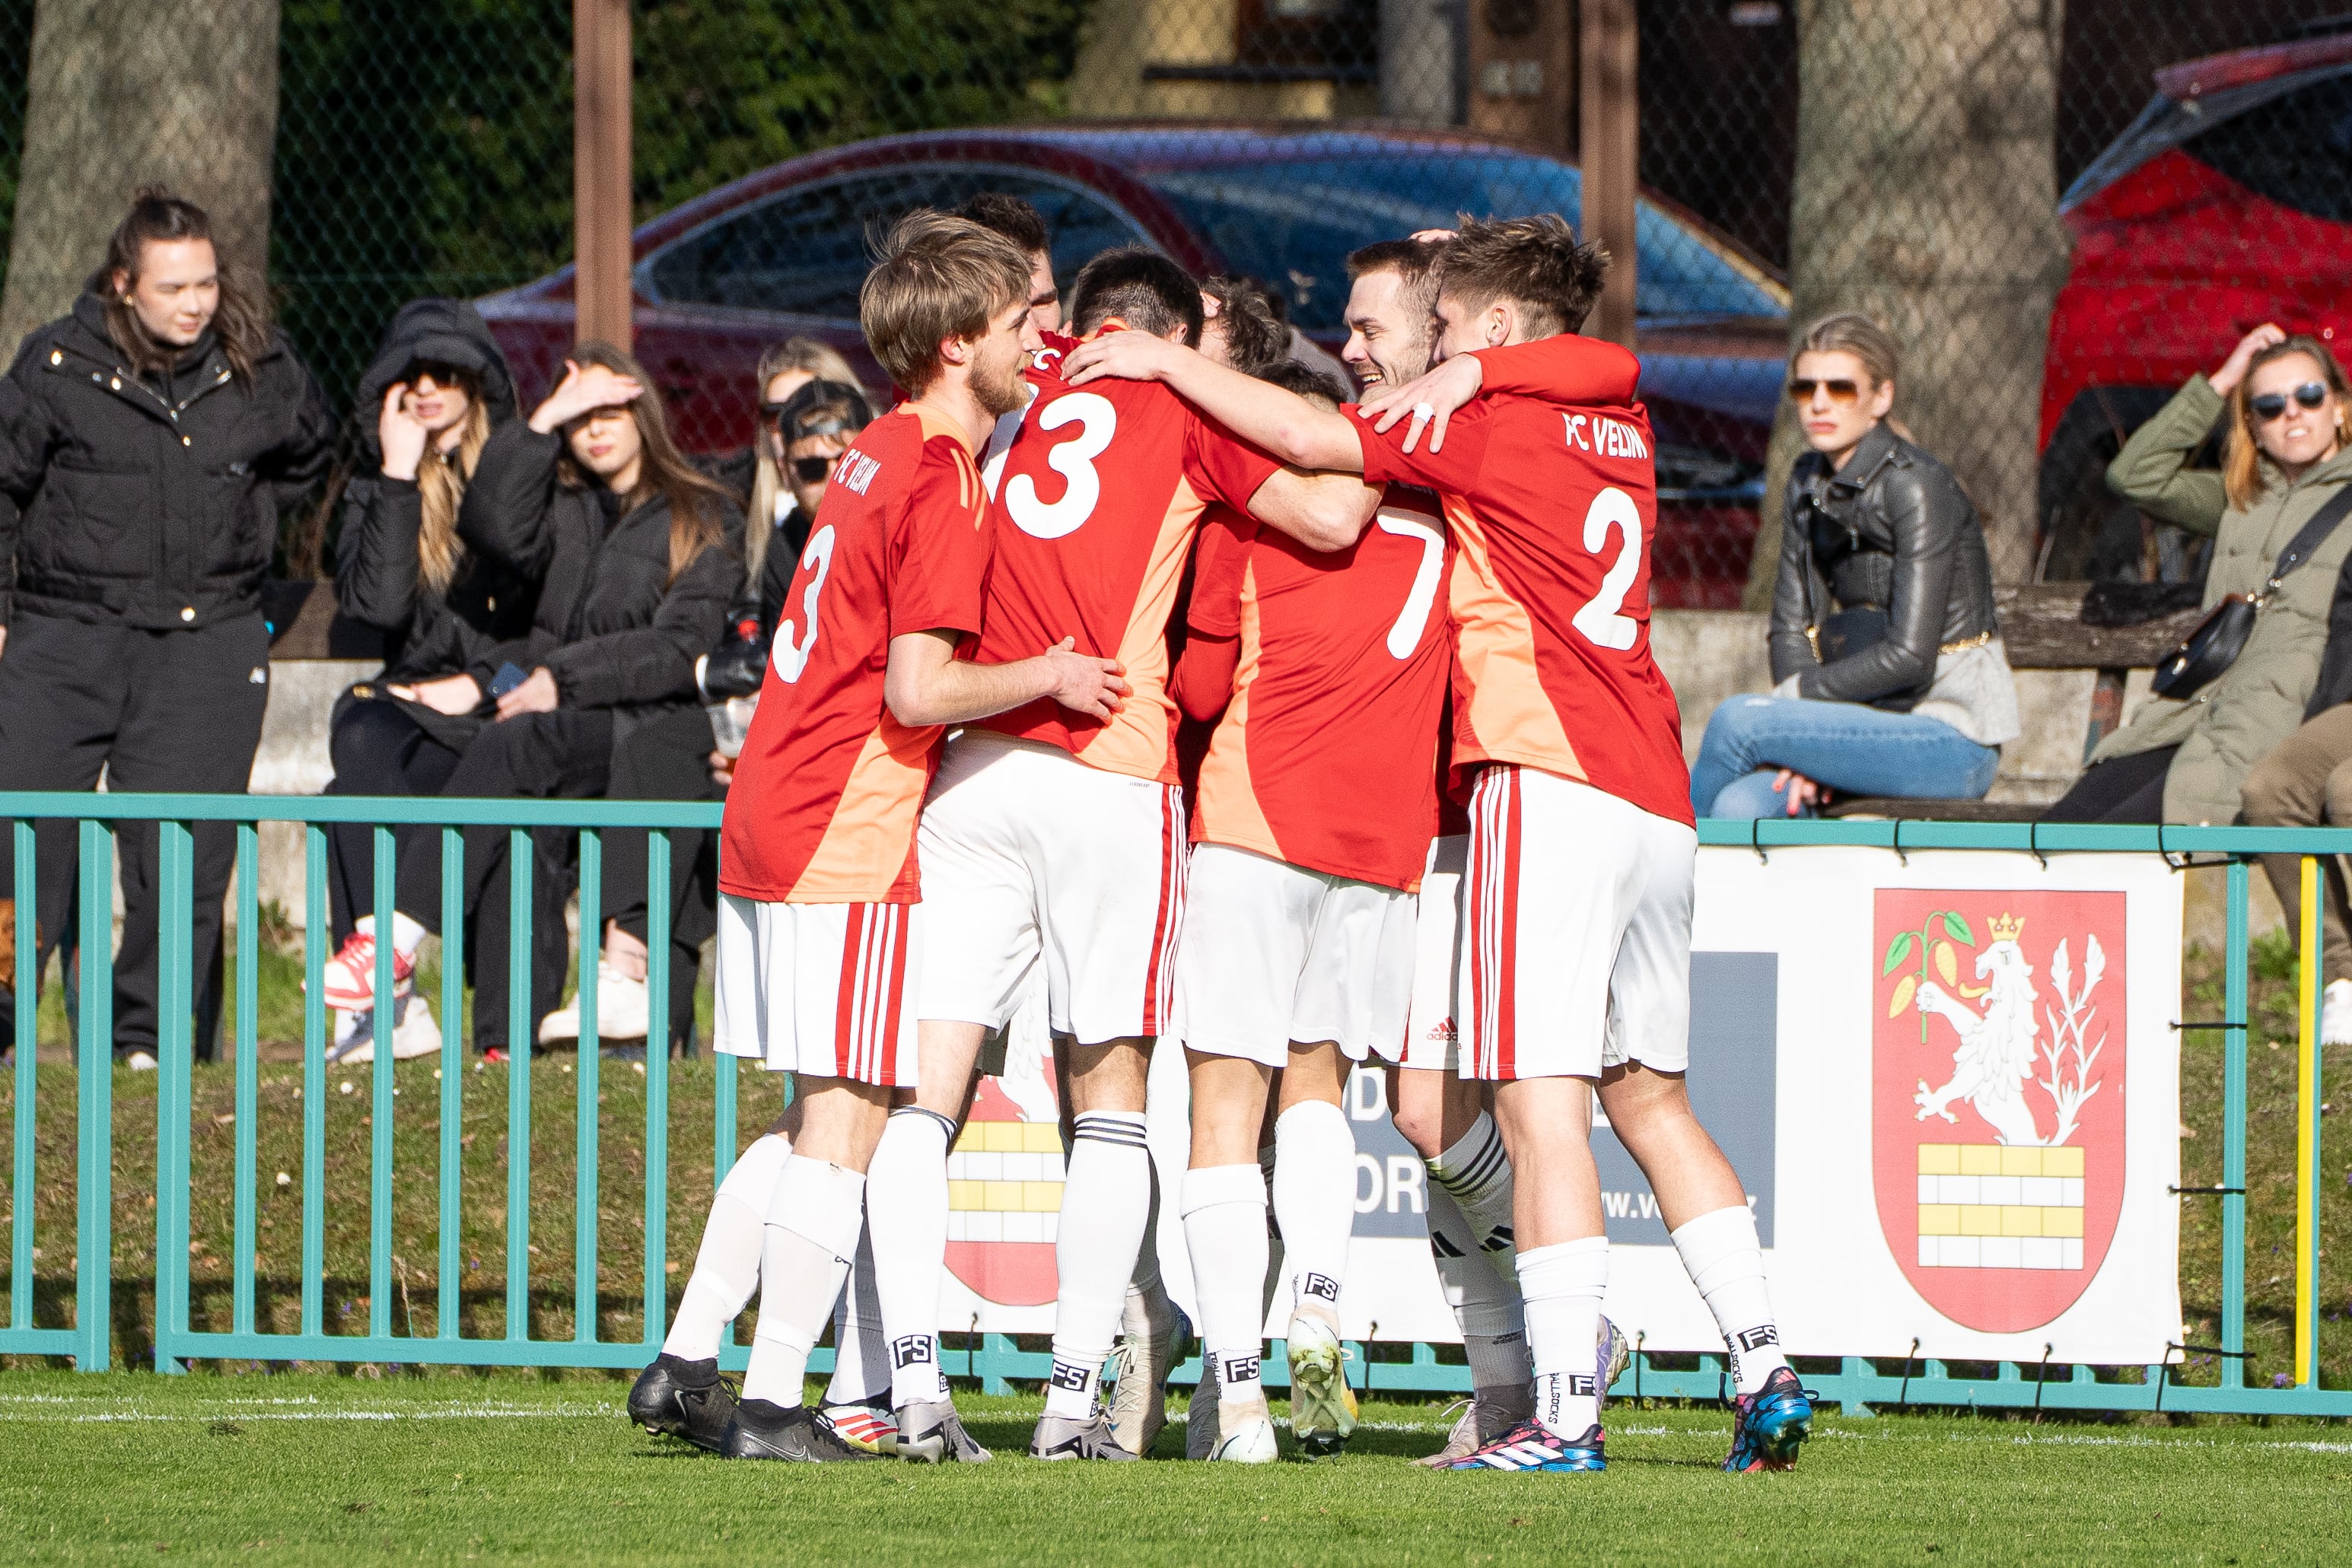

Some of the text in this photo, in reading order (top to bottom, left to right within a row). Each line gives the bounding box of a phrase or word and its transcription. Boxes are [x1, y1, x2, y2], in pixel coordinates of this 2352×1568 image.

[1562, 412, 1647, 459] FC VELIM
[833, 448, 861, 484] FC
[1377, 506, 1446, 660] 7
[1571, 486, 1642, 651] 2
[772, 524, 835, 684] 3
[1427, 1031, 1459, 1042] adida
[1306, 1273, 1337, 1300] FS
[896, 1335, 929, 1367] FS
[1743, 1326, 1778, 1349] FS
[1051, 1360, 1086, 1391] FS
[1229, 1356, 1259, 1382] FS
[1574, 1376, 1596, 1395] F
